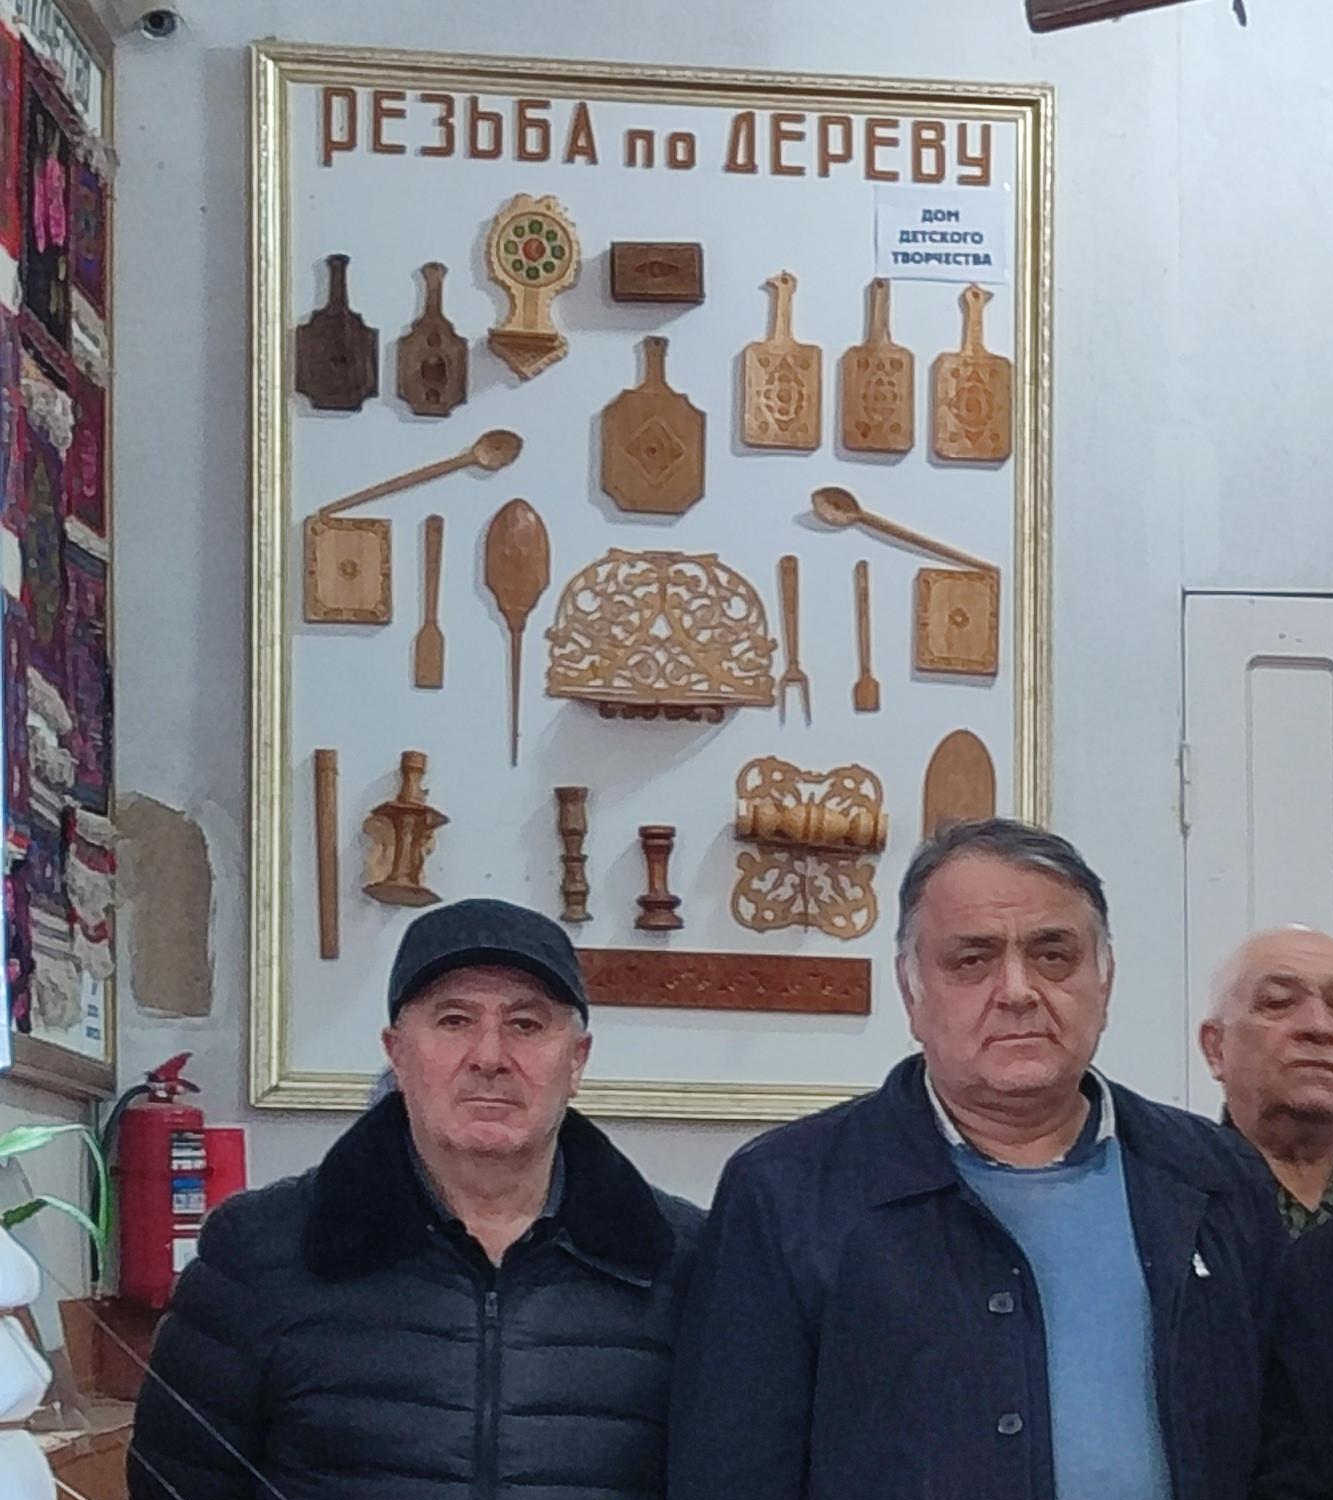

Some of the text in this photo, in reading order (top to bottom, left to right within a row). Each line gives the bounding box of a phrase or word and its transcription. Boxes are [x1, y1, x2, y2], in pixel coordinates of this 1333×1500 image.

[323, 86, 992, 187] РЕЗЬБА по ДЕРЕВУ
[921, 208, 960, 223] ДОМ
[899, 230, 984, 245] ДЕТСКОГО
[891, 251, 992, 266] ТВОРЧЕСТВА
